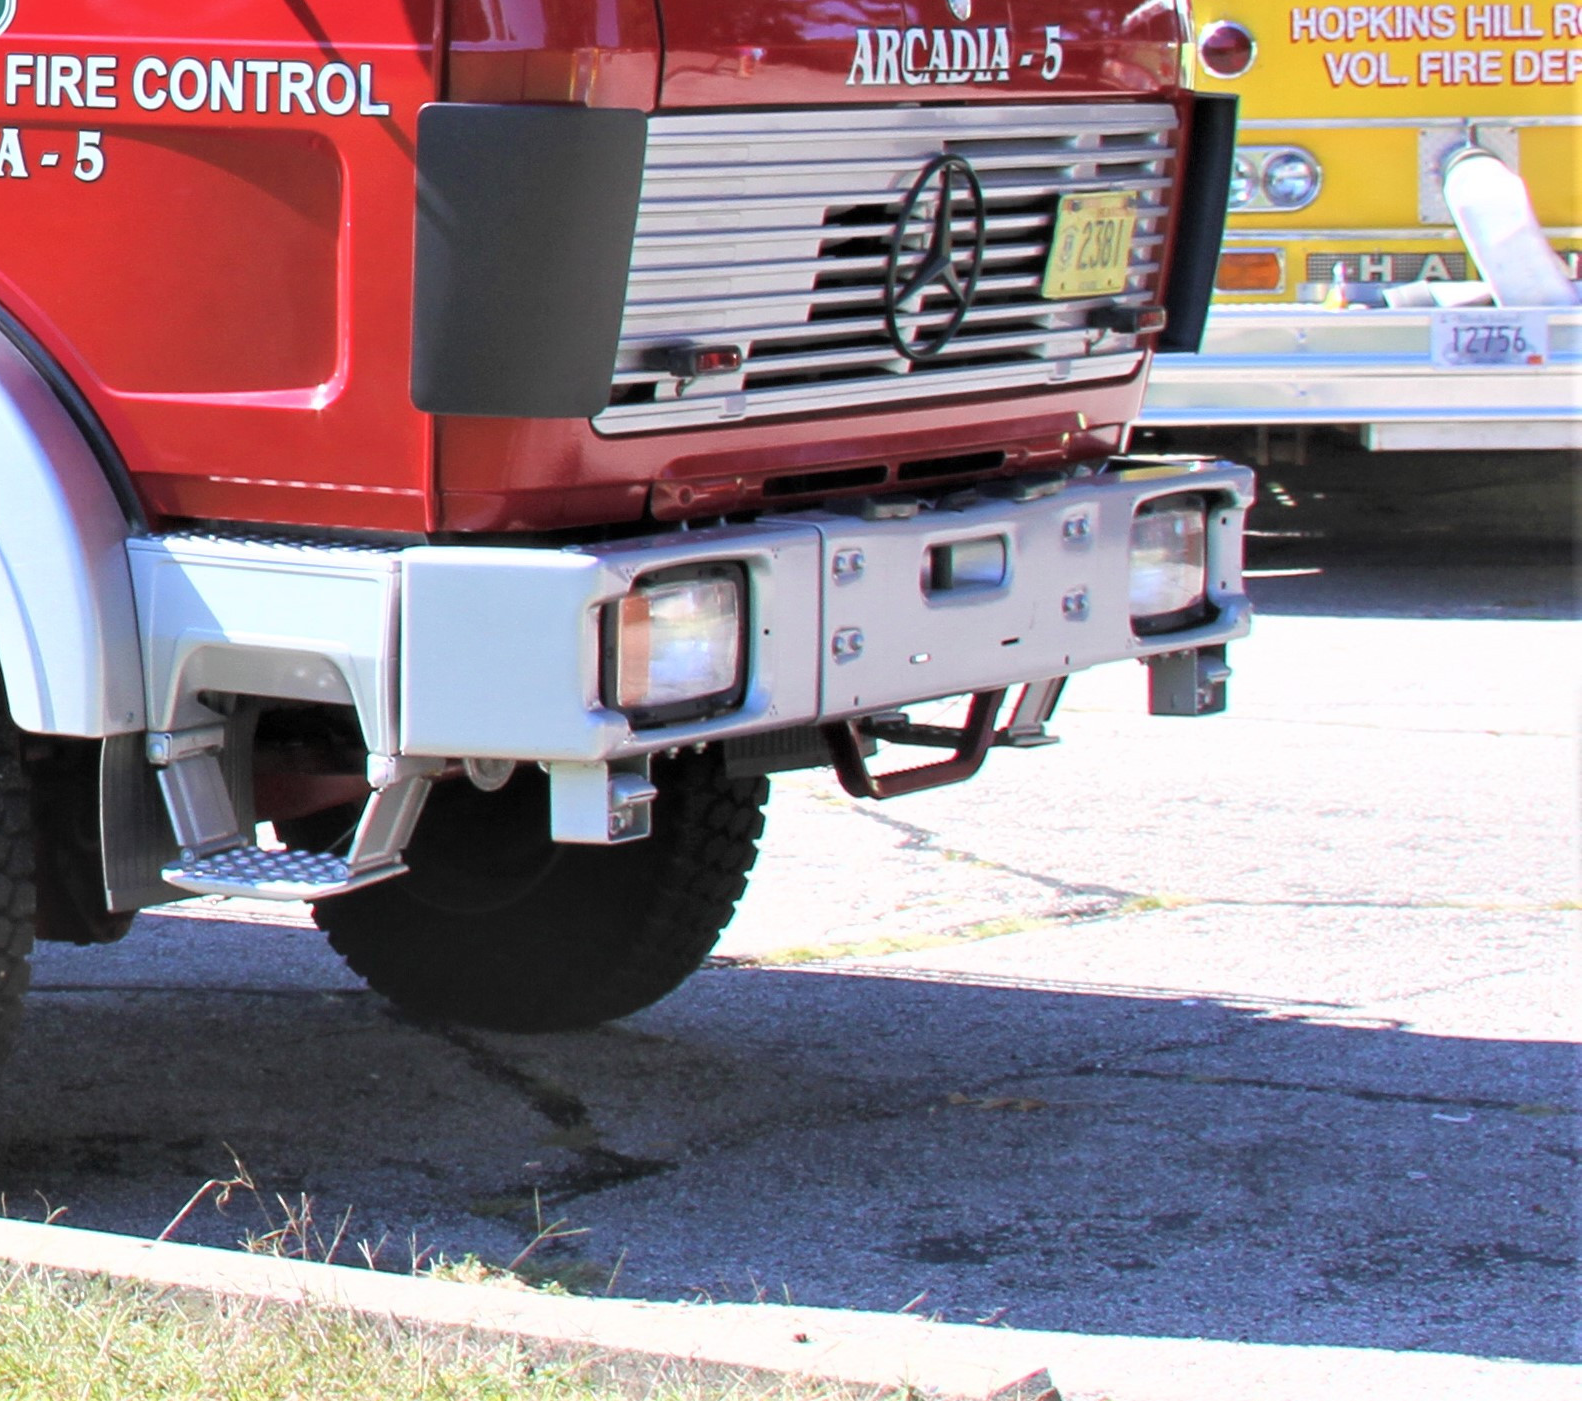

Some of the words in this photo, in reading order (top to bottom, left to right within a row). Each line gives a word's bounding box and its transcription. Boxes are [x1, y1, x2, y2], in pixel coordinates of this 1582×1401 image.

[1290, 3, 1457, 42] HOPKINS
[1464, 3, 1544, 41] HILL
[1552, 2, 1582, 40] R
[845, 26, 1012, 87] ARCADIA
[1040, 24, 1065, 82] 5
[1323, 50, 1410, 88] VOL.
[1417, 50, 1504, 87] FIRE
[5, 55, 119, 109] FIRE
[131, 57, 391, 118] CONTROL
[72, 130, 105, 183] 5
[1077, 218, 1125, 271] 2381
[1451, 325, 1527, 354] 12756
